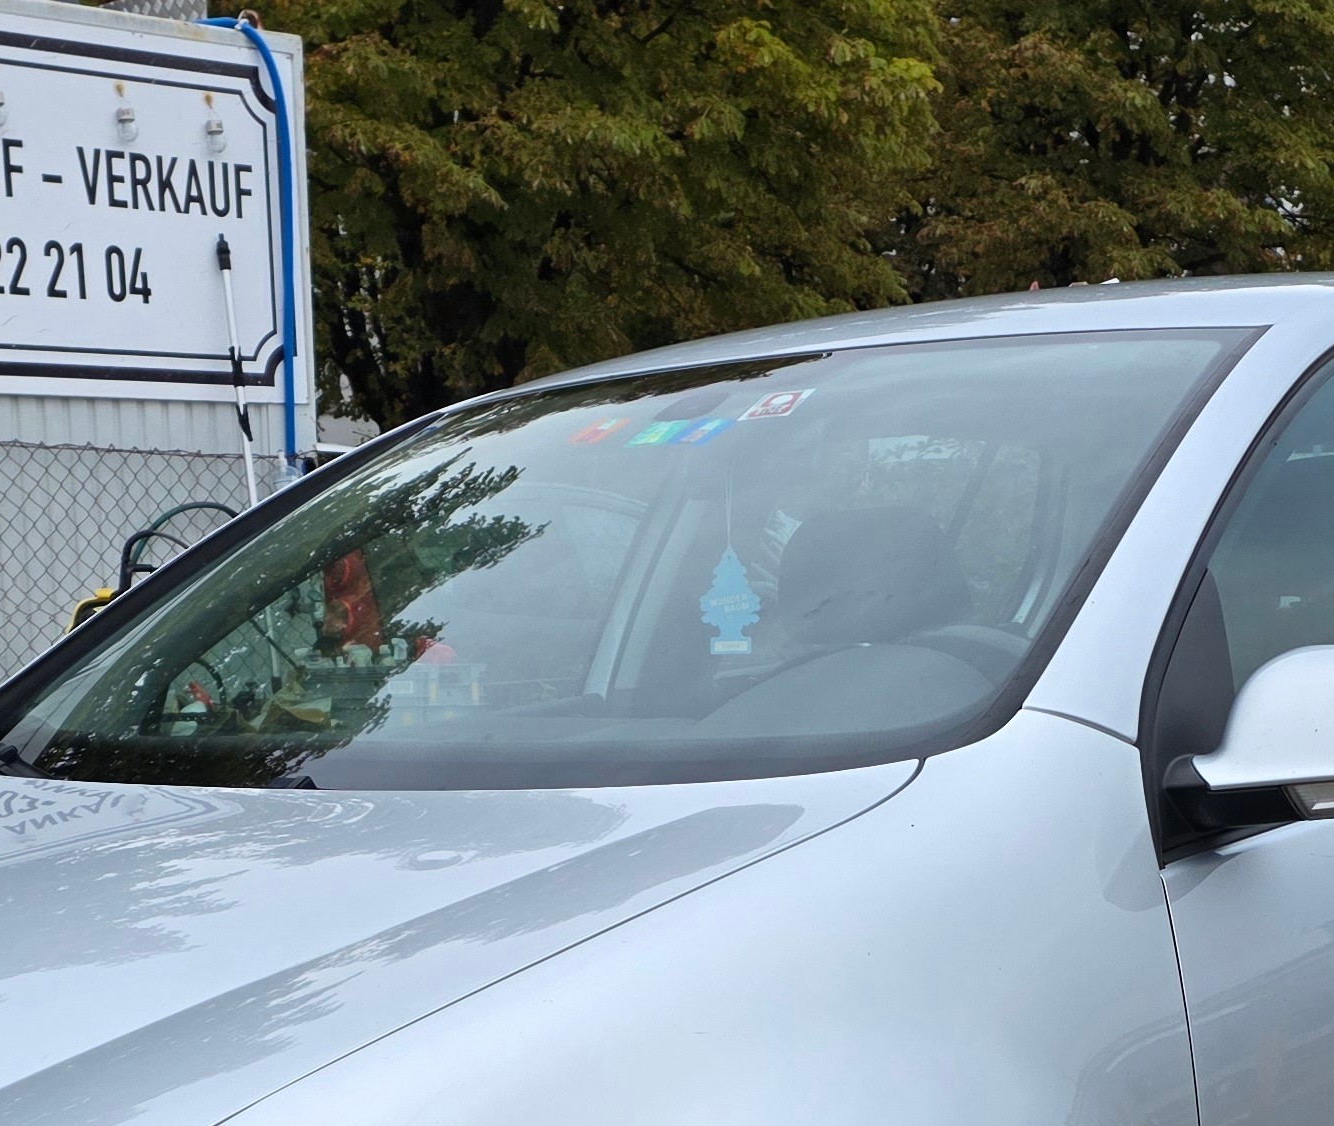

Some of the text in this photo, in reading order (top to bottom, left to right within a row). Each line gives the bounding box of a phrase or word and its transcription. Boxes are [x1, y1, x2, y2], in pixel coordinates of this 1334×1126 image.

[75, 144, 253, 220] VERKAUF
[43, 239, 89, 301] 21
[105, 244, 153, 305] 04
